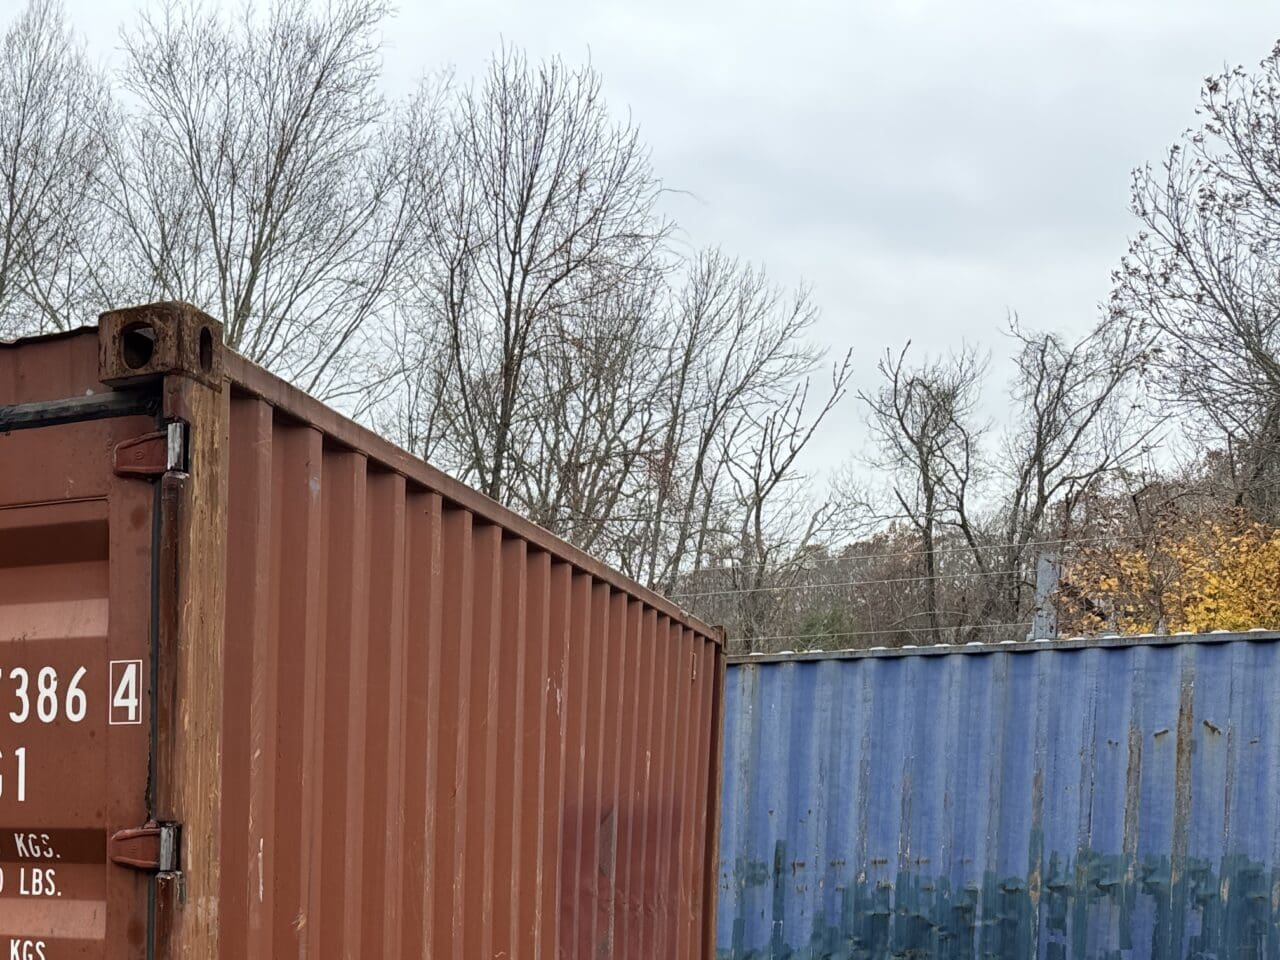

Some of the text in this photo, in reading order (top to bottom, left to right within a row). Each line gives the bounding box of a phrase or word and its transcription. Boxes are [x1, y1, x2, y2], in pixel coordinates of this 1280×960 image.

[113, 663, 139, 721] 4
[14, 832, 61, 859] KGS.
[20, 867, 62, 897] LBS.
